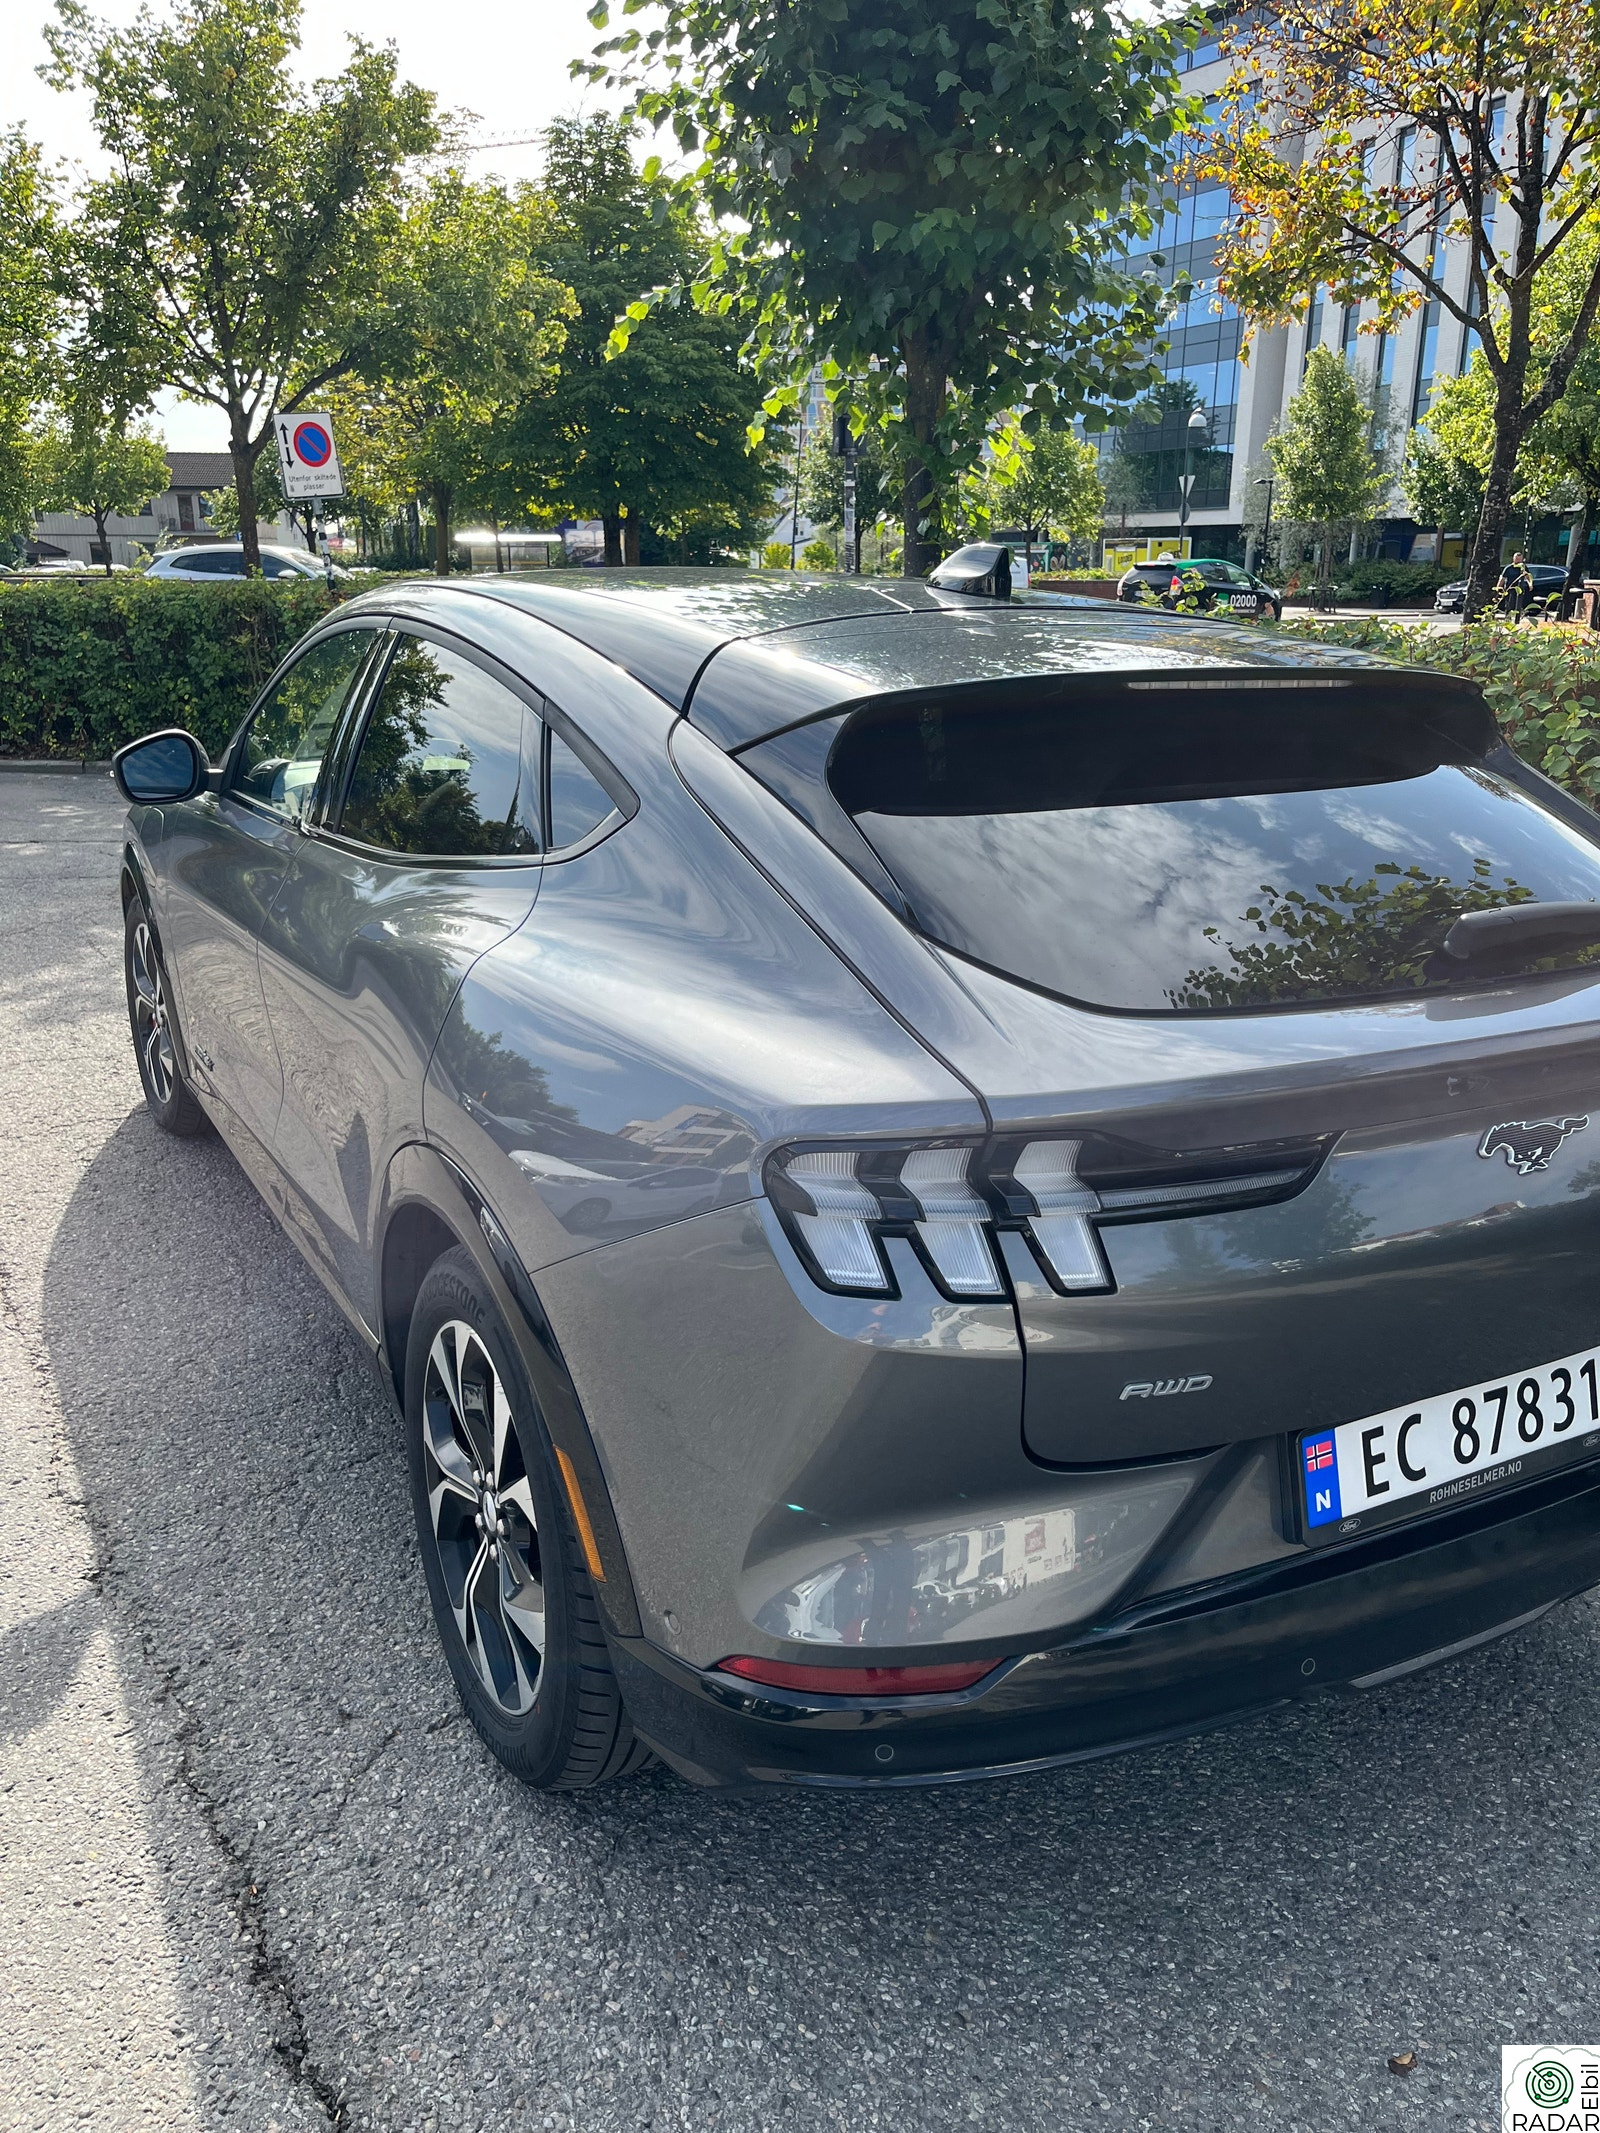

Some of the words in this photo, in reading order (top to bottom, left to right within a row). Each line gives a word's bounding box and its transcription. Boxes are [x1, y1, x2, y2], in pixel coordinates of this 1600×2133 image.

[314, 473, 336, 481] skiltede
[1230, 594, 1257, 607] 02000
[1119, 1375, 1213, 1400] AWD
[1361, 1413, 1427, 1498] EC
[1452, 1359, 1599, 1465] 87831
[1315, 1489, 1332, 1512] N
